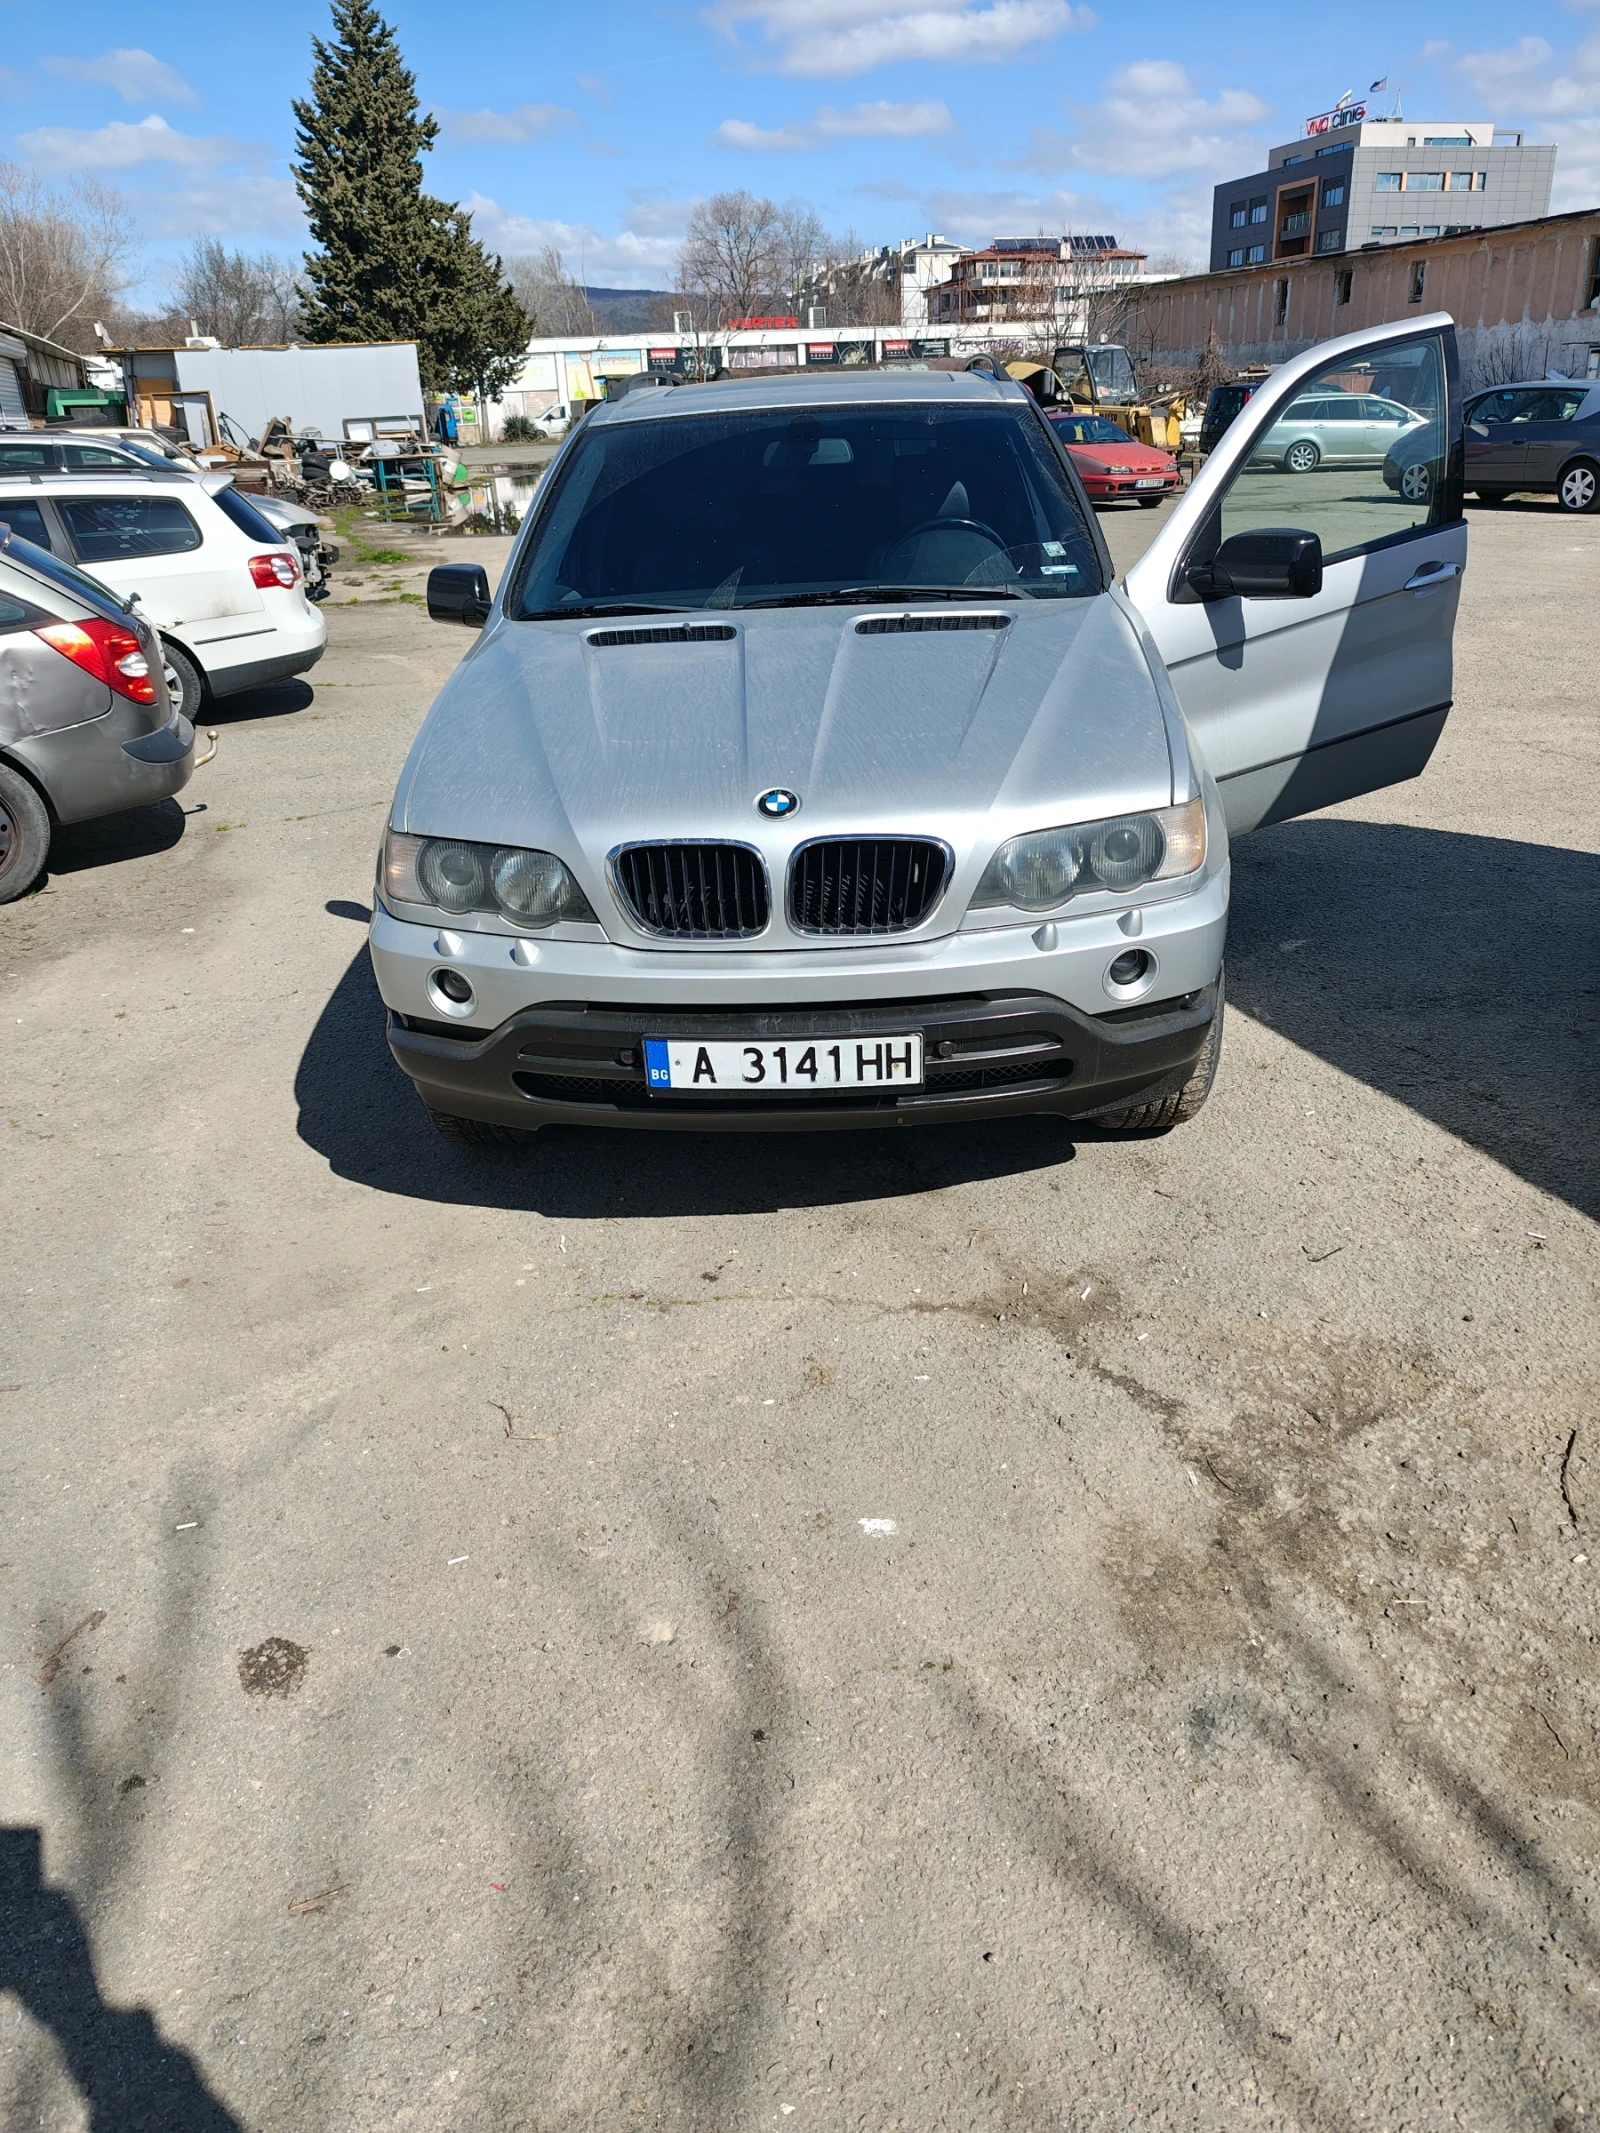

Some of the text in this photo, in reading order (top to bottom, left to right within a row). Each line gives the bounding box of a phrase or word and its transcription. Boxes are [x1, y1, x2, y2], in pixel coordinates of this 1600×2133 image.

[728, 316, 798, 330] VERTEX
[692, 1041, 912, 1084] A 3141HH
[651, 1069, 669, 1080] BG
